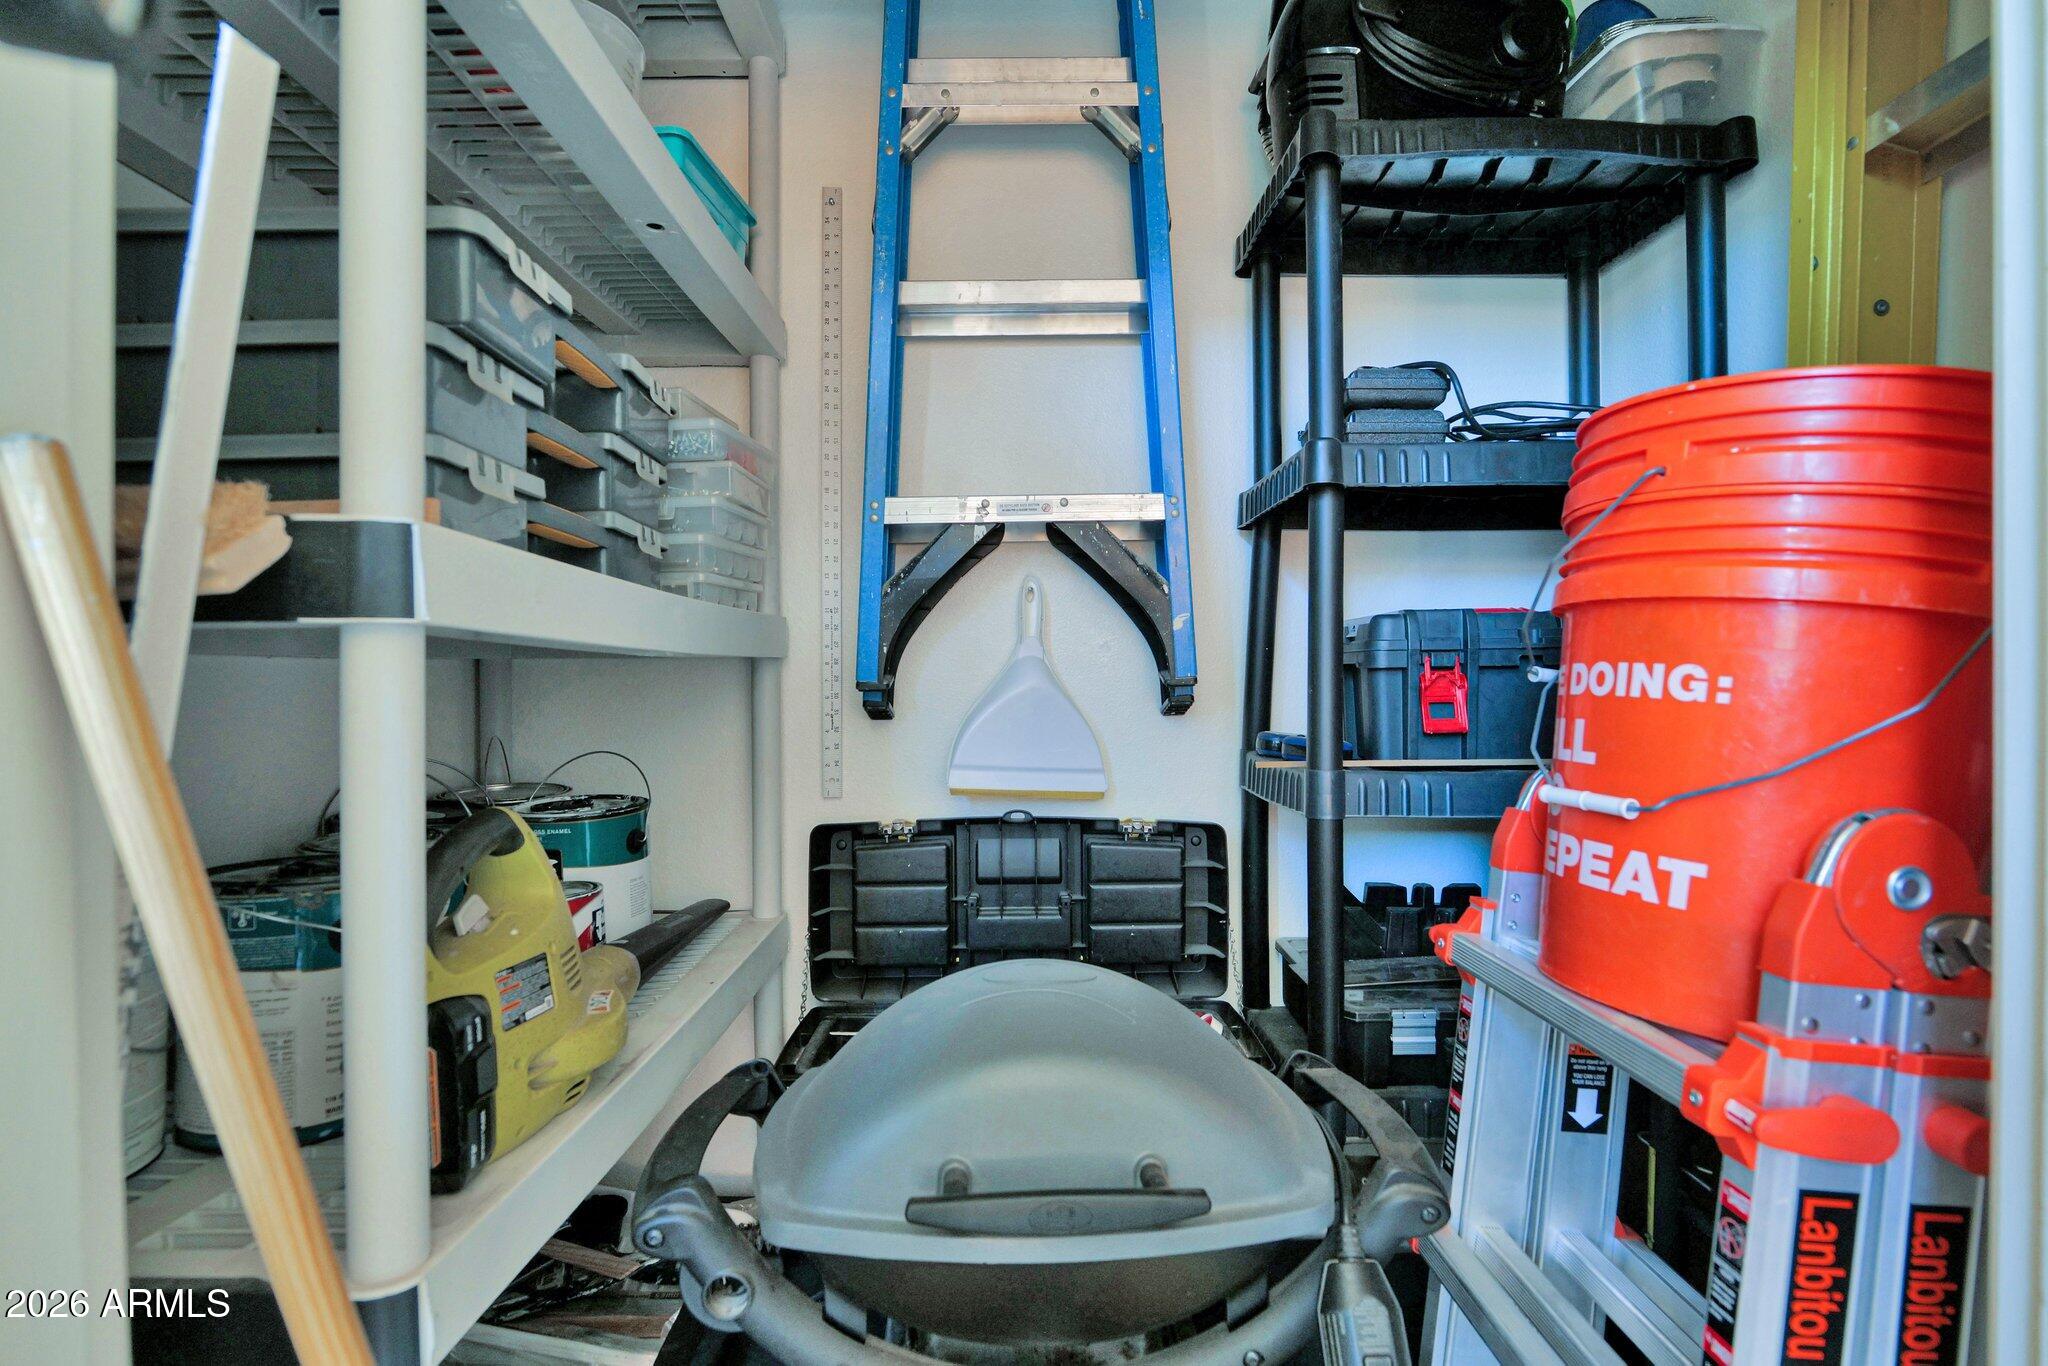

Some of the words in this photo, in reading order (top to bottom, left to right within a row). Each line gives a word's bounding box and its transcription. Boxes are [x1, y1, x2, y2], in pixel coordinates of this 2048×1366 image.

[1570, 661, 1734, 705] DOING:
[1557, 718, 1597, 766] LL
[1546, 830, 1709, 911] EPEAT
[1786, 1196, 1854, 1361] Lanbitou
